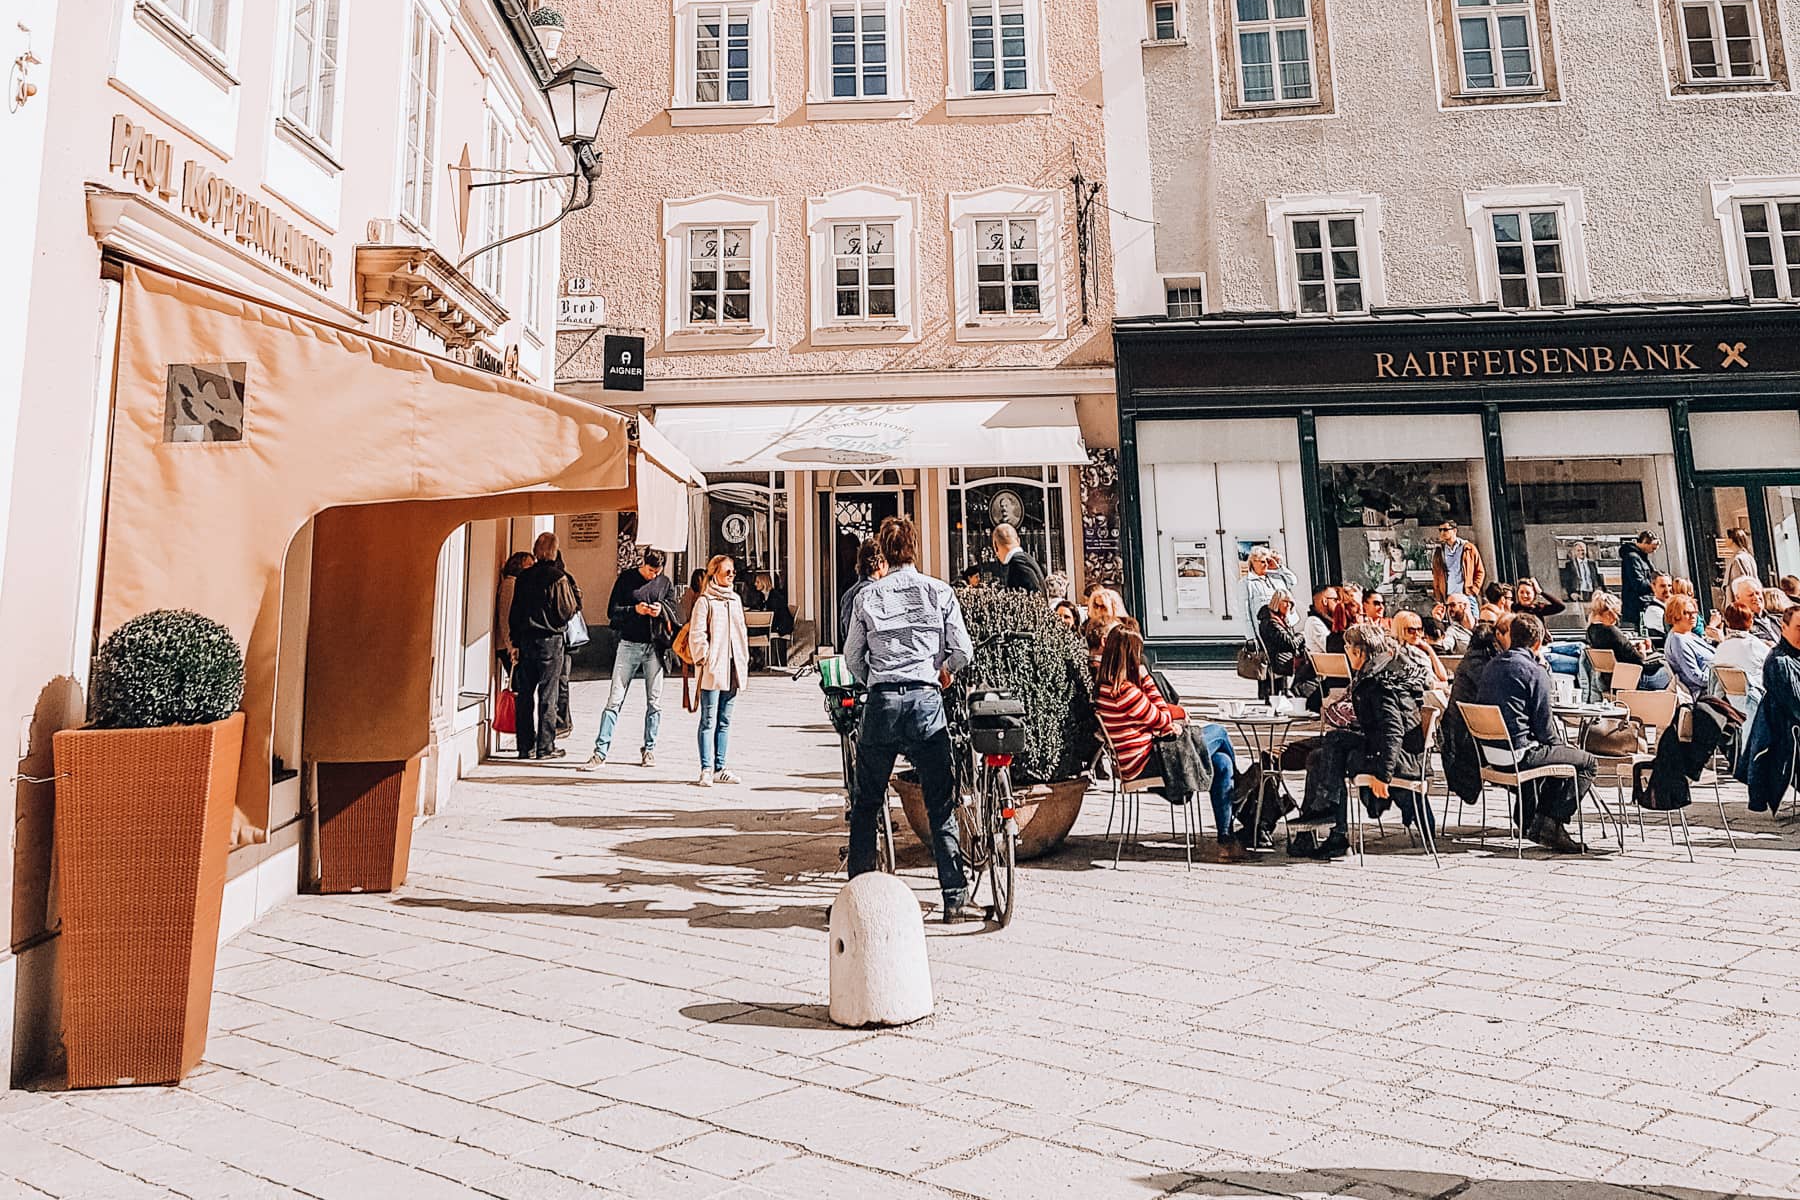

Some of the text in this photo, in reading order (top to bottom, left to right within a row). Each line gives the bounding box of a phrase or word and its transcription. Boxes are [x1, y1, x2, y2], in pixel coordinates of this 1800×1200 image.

[110, 114, 178, 202] PAUL
[573, 278, 586, 290] 13
[609, 366, 643, 376] AIGNER
[1374, 343, 1701, 378] RAIFFEISENBANK
